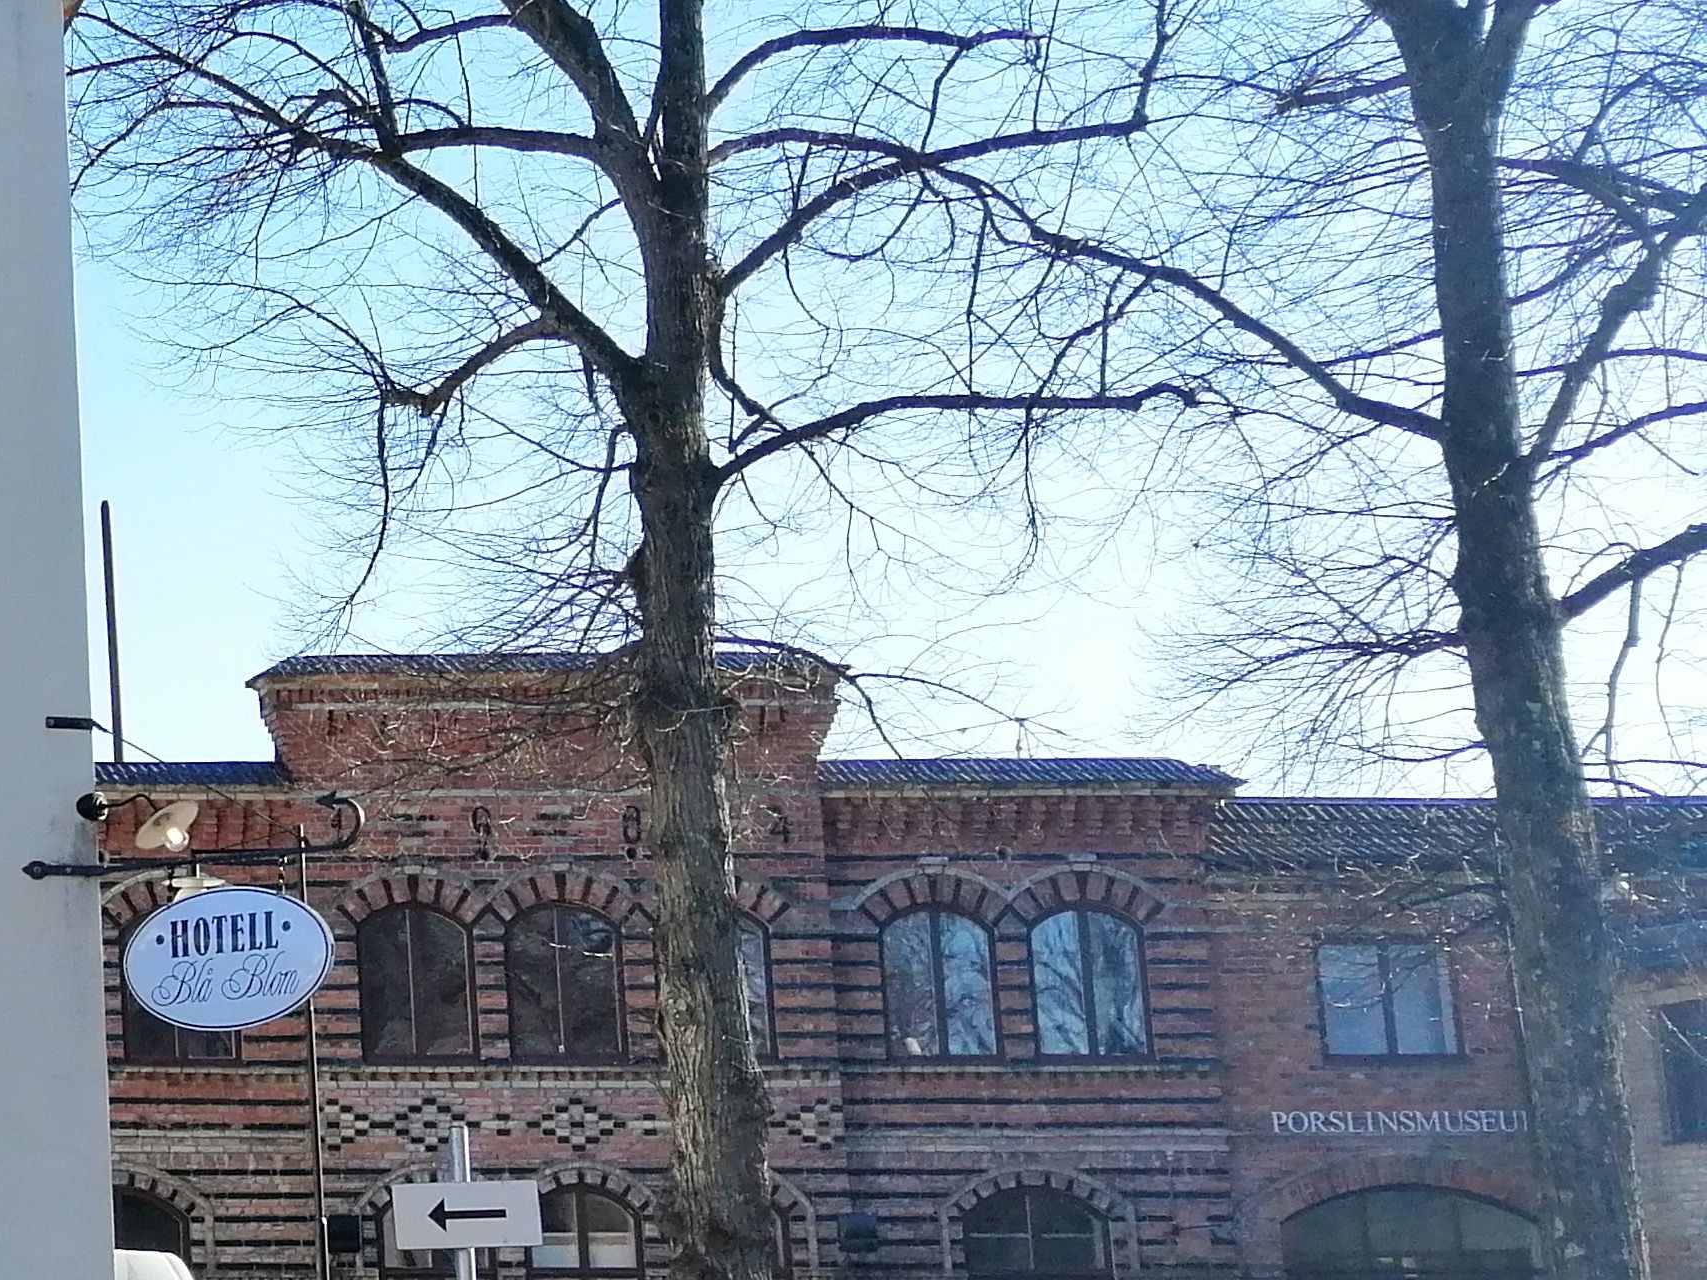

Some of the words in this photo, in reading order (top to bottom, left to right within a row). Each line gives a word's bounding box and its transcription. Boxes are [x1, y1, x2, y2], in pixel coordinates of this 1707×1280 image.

[170, 911, 279, 959] HOTELL
[151, 957, 214, 1007] Blå
[221, 950, 300, 1001] Blom
